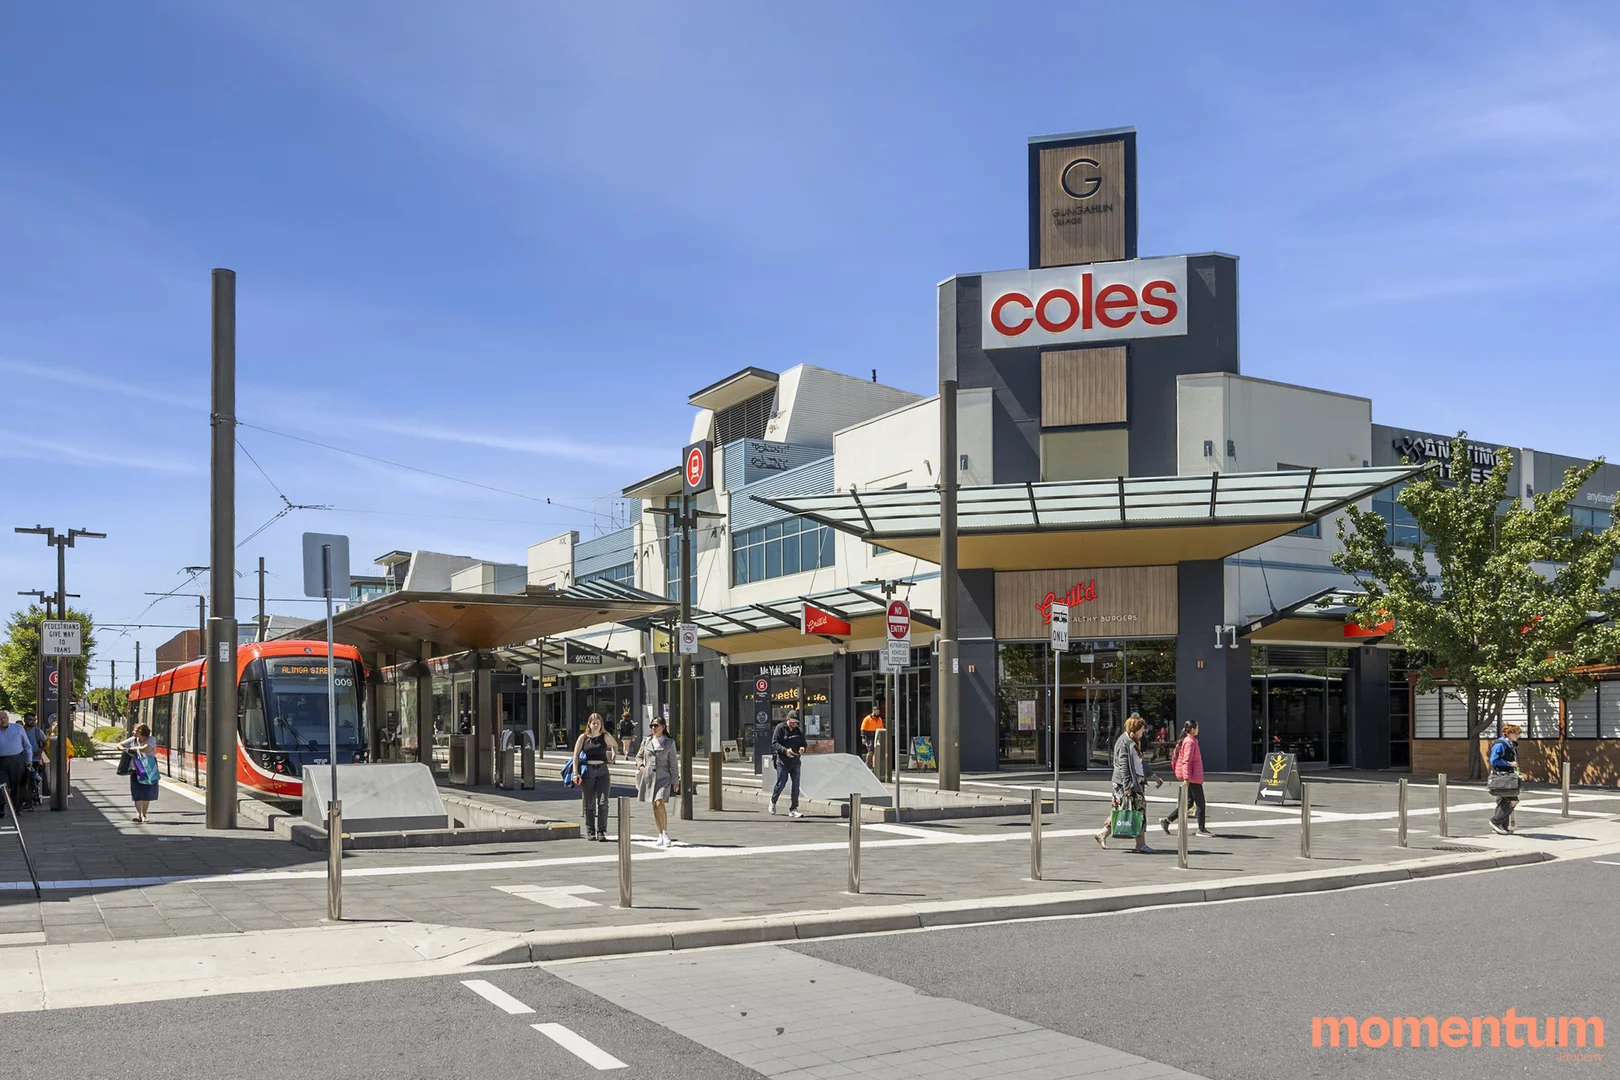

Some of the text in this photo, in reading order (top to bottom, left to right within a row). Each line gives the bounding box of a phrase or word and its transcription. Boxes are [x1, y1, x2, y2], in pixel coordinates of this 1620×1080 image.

[1061, 158, 1102, 199] G
[1052, 204, 1113, 217] GUNGAHLIN
[990, 273, 1178, 336] coles
[894, 606, 902, 614] NO
[1053, 630, 1068, 642] ONLY
[769, 666, 781, 676] Yuki
[782, 664, 802, 676] Bakery
[334, 678, 352, 686] 009
